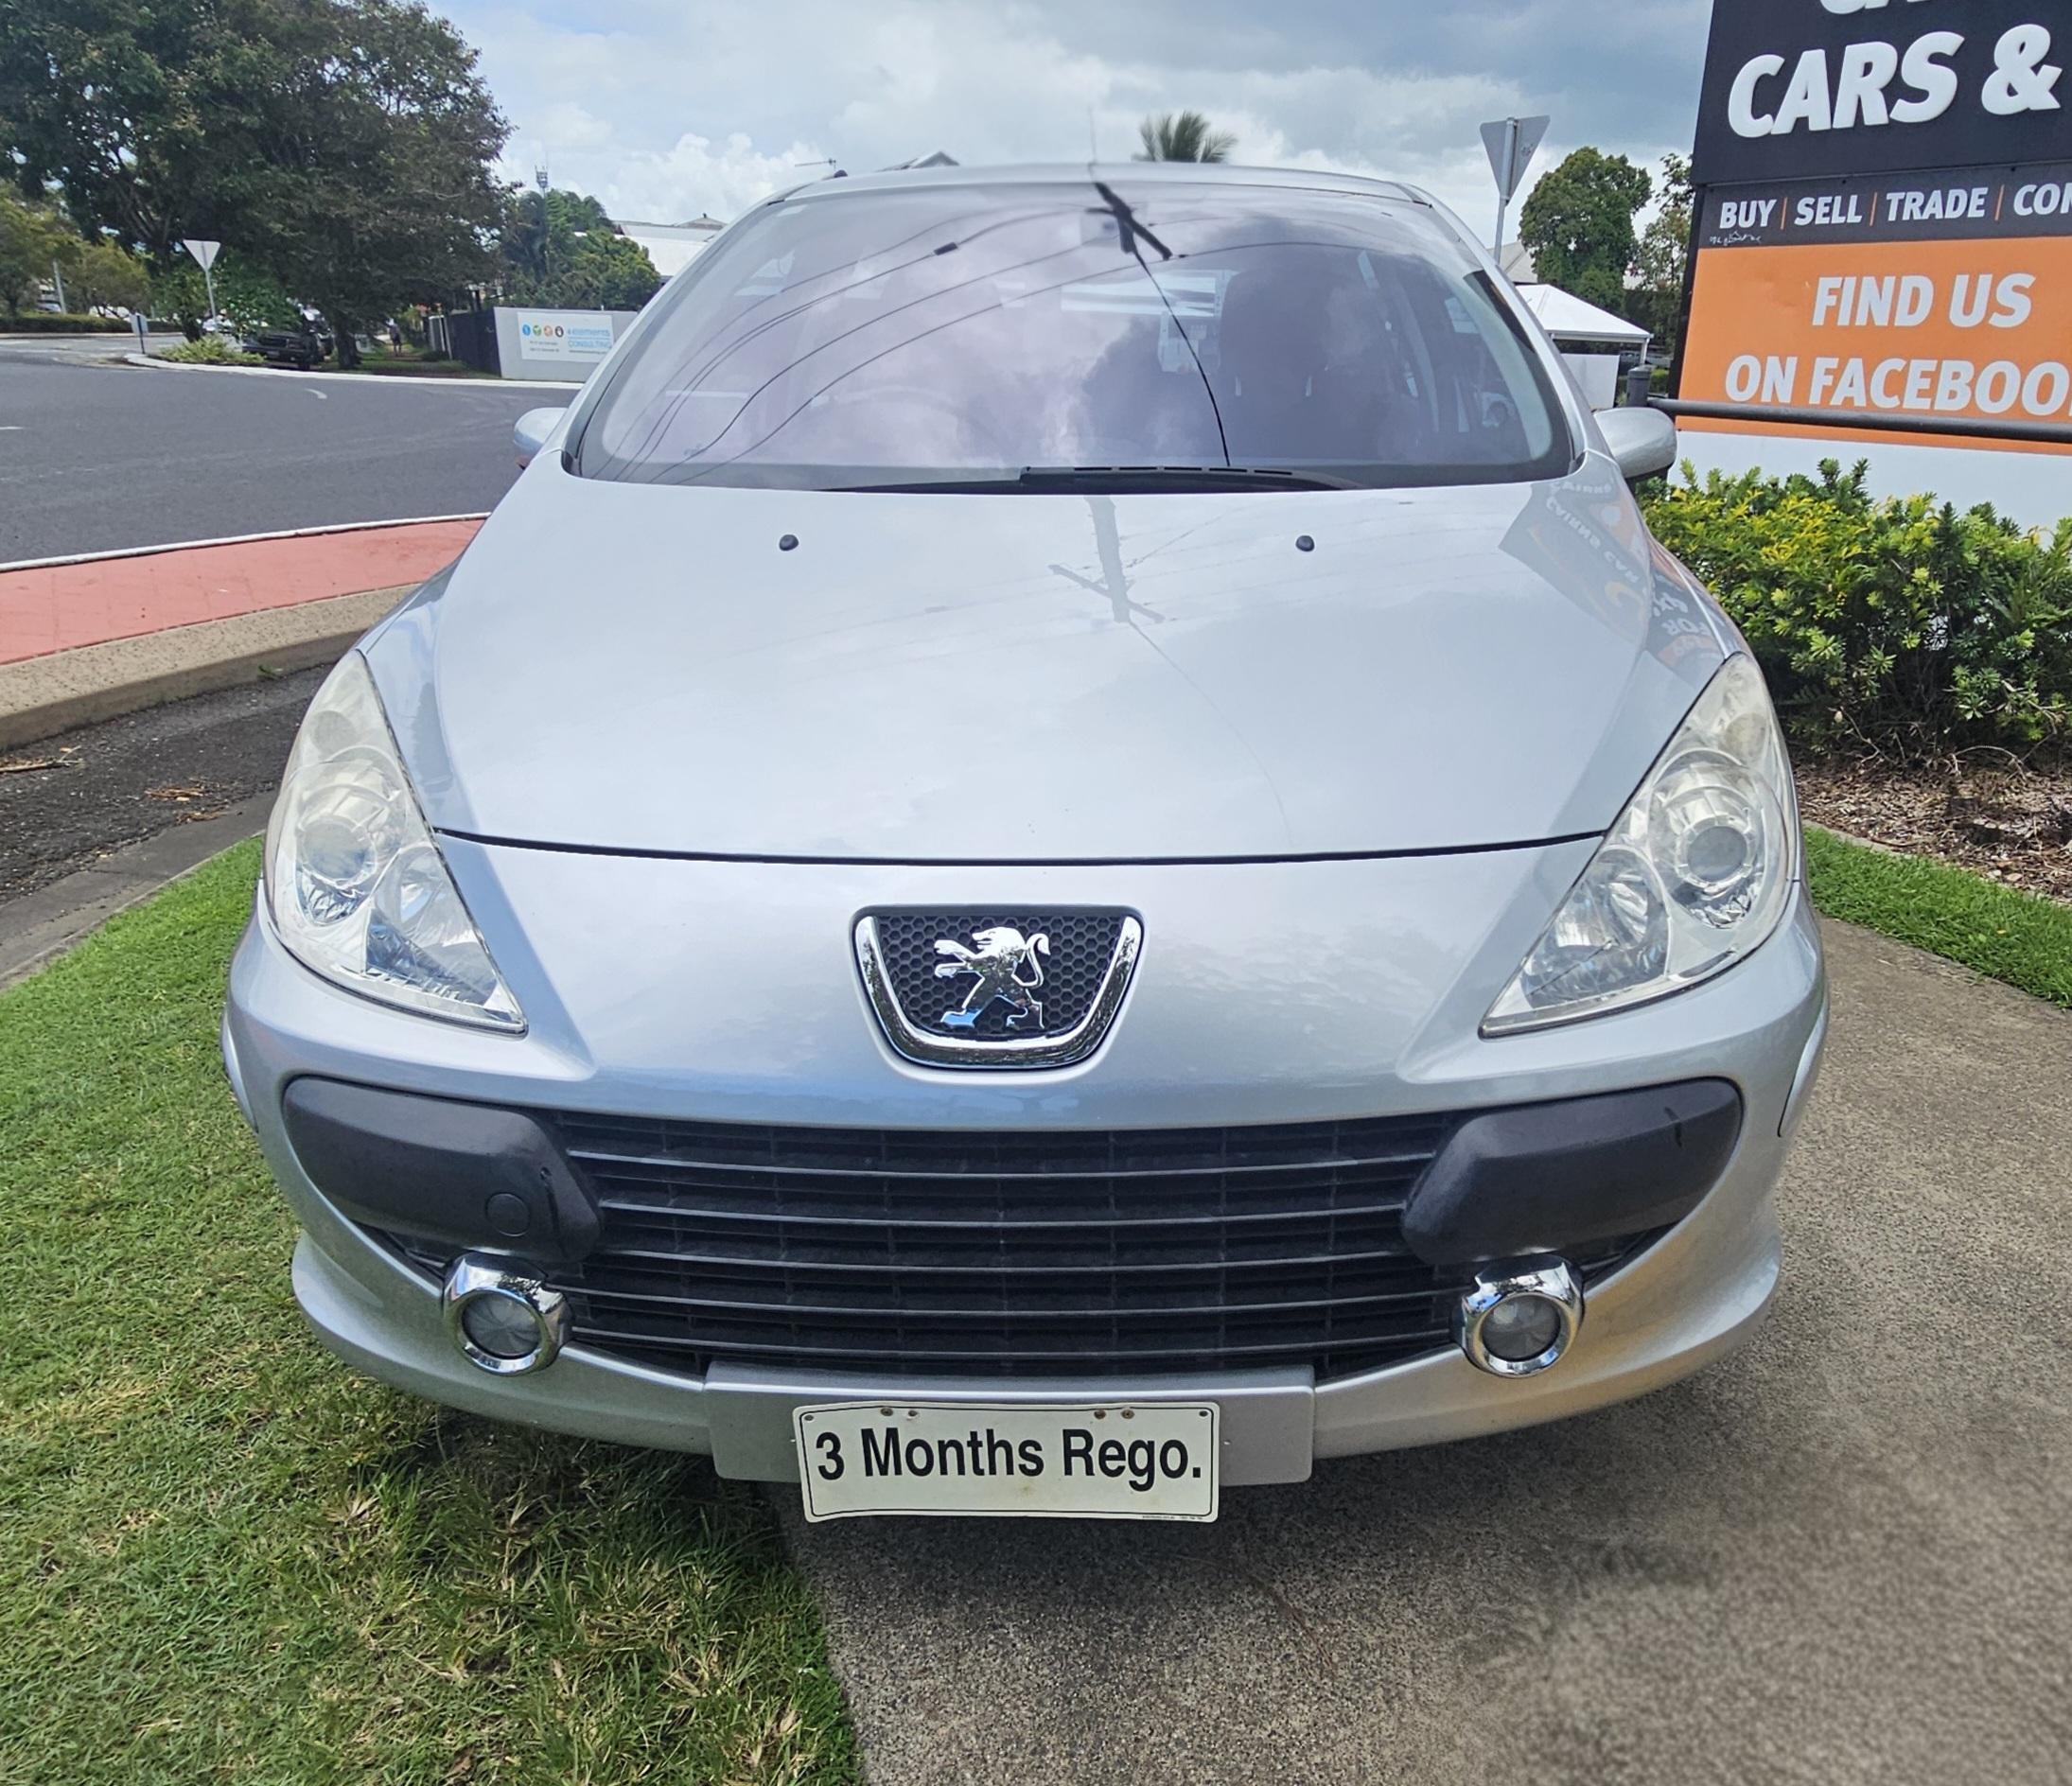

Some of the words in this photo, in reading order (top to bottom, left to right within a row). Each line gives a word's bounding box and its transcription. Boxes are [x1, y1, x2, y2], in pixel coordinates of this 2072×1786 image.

[1728, 31, 1965, 138] CARS
[1981, 24, 2063, 115] &
[1719, 199, 1777, 229] BUY
[1795, 194, 1863, 226] SELL
[1886, 187, 1988, 221] TRADE
[1812, 275, 1934, 326] FIND
[1948, 273, 2036, 328] US
[1725, 356, 1798, 403] ON
[1808, 358, 2072, 416] FACEBOO
[816, 1431, 845, 1480] 3
[860, 1427, 1045, 1478] Months
[1062, 1427, 1202, 1491] Rego.
